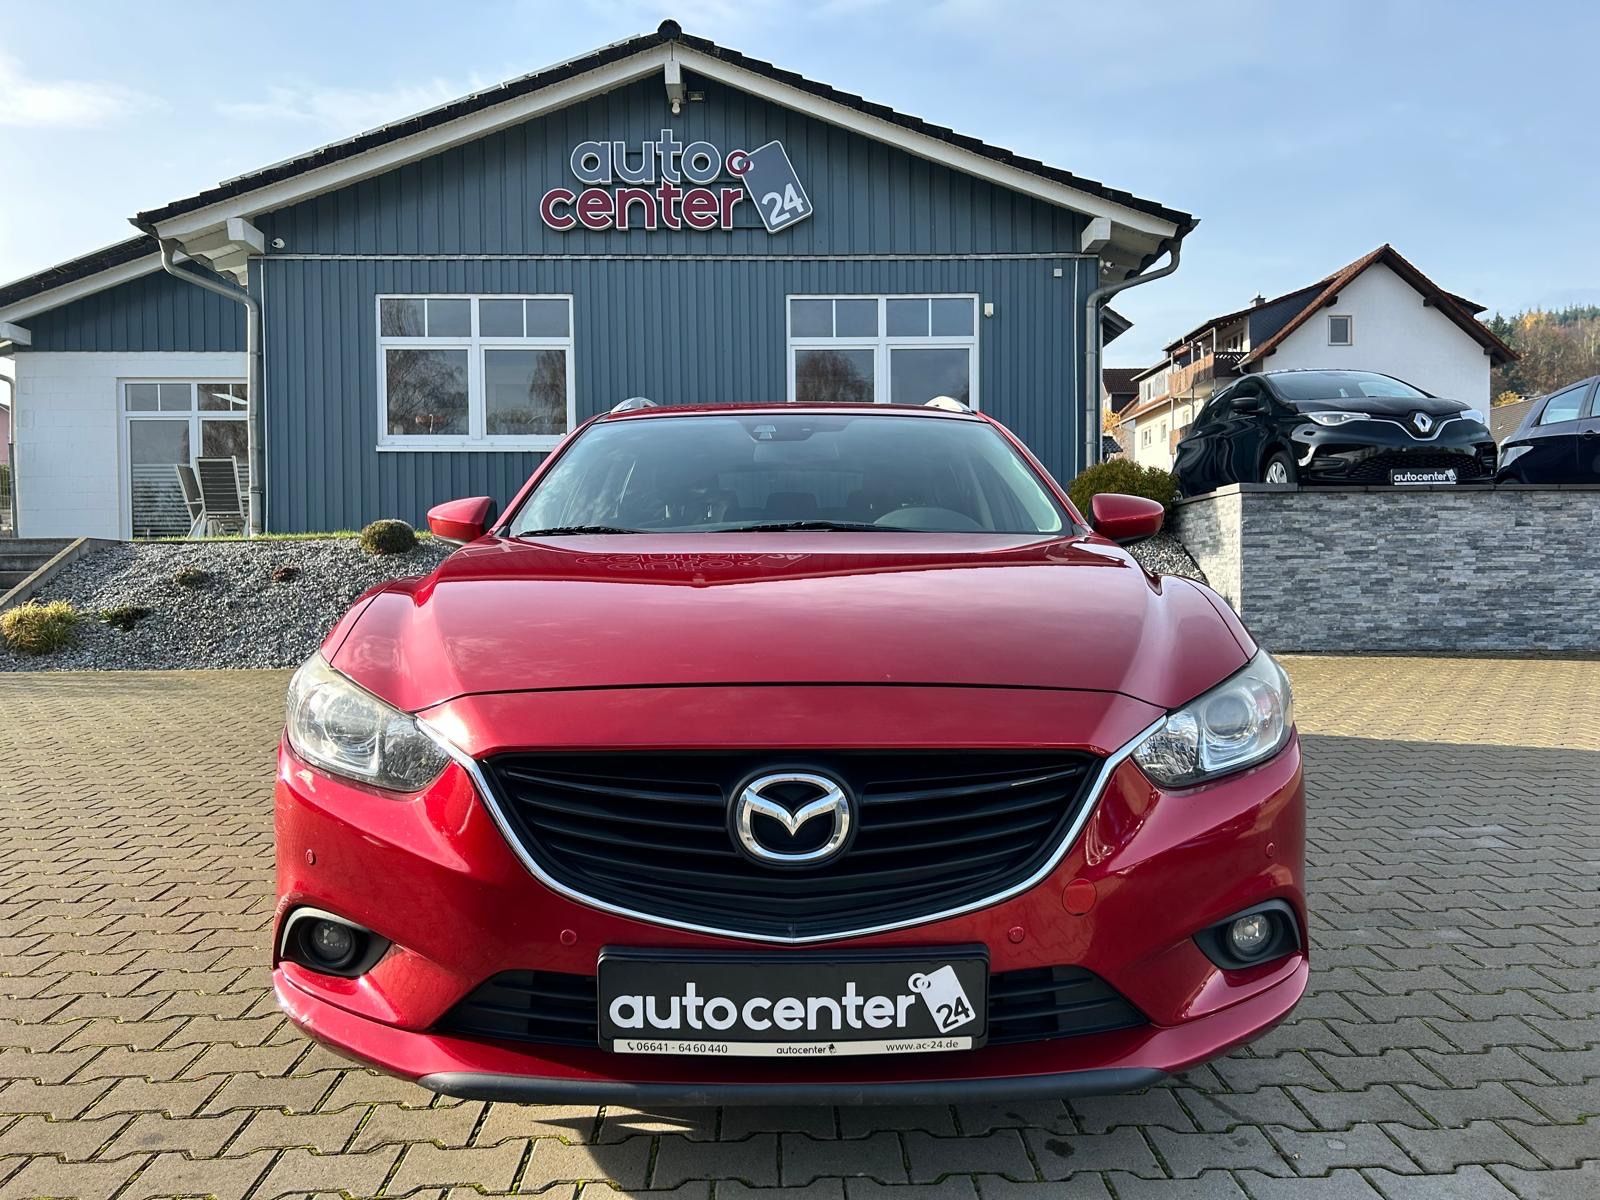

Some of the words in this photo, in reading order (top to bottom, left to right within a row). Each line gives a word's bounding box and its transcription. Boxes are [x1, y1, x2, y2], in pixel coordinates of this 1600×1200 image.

[570, 129, 722, 185] auto
[540, 176, 743, 231] center
[761, 183, 805, 226] 24
[936, 996, 970, 1029] 24
[636, 1042, 668, 1052] 06641
[776, 1044, 827, 1054] autocenter
[886, 1040, 959, 1052] www.ac-24.de
